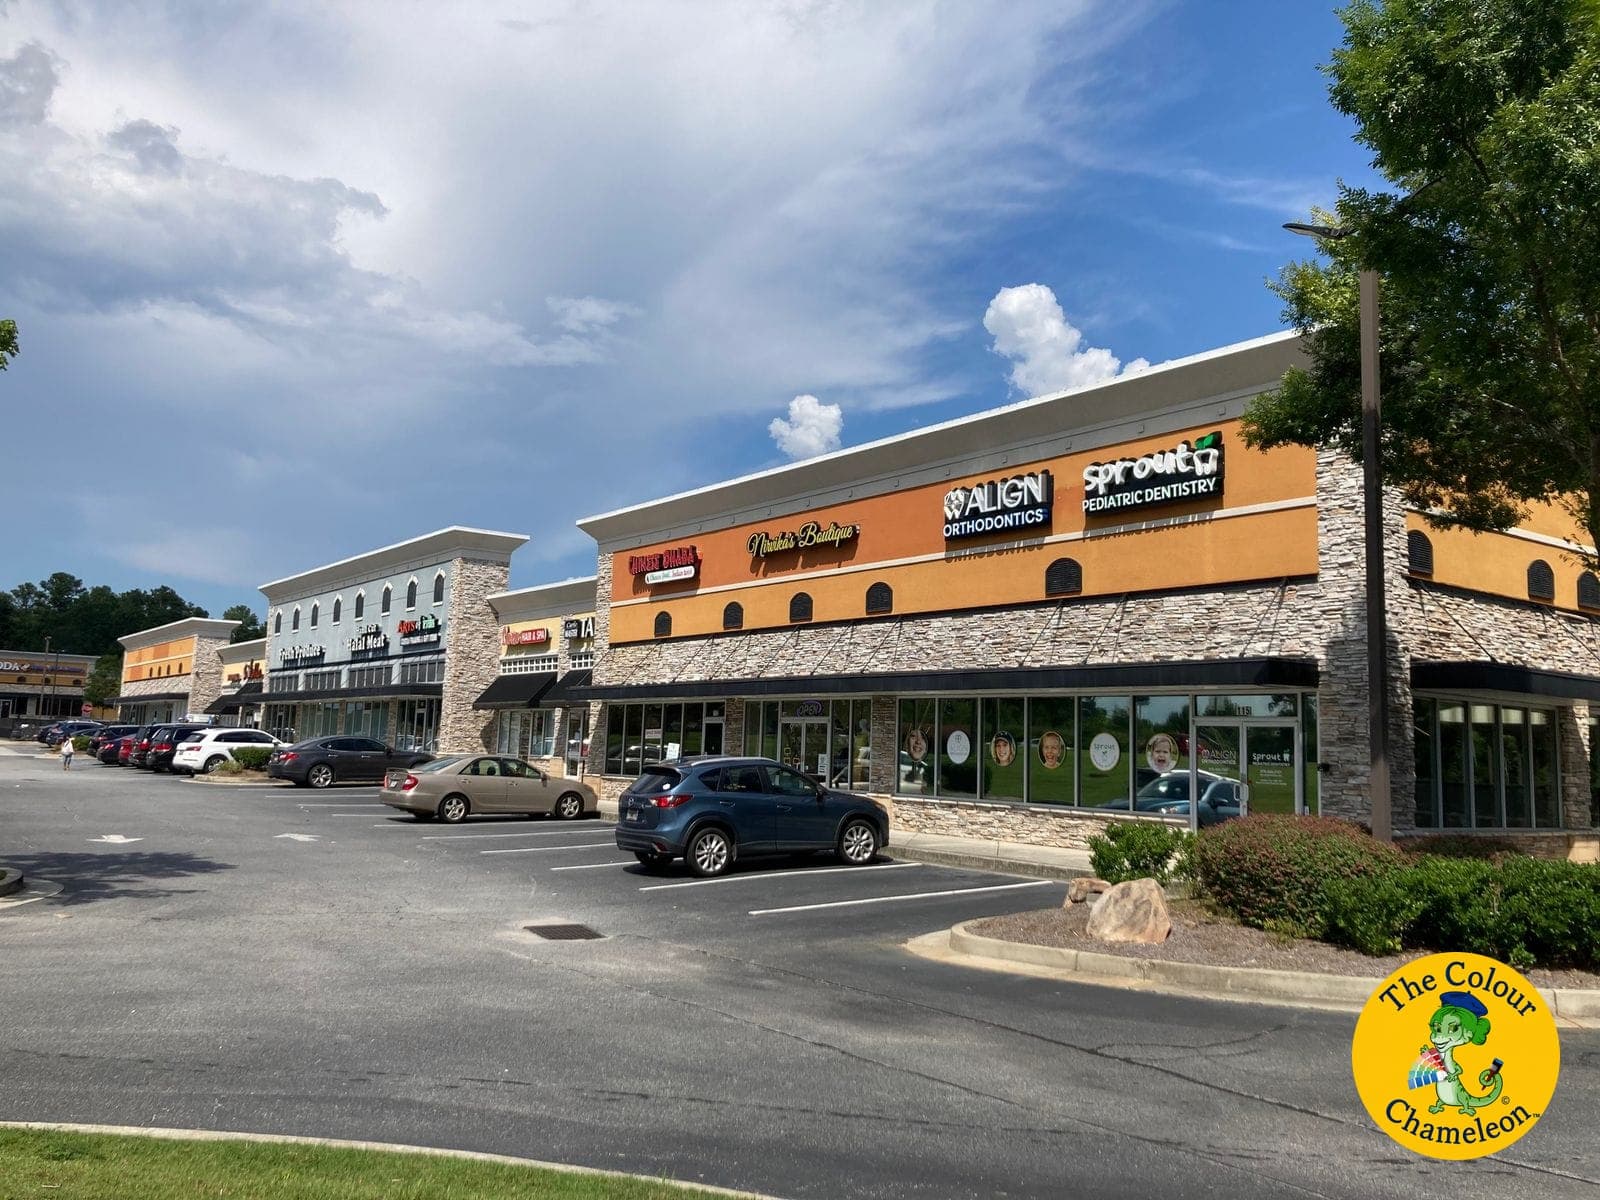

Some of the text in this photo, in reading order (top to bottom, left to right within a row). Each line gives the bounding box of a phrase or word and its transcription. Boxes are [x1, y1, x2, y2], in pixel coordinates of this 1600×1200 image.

[1083, 443, 1195, 495] sprout
[965, 473, 1044, 516] ALIGN
[1082, 477, 1216, 512] PEDIATRIC DENTISTRY
[943, 508, 1044, 537] ORTHODONTICS
[747, 522, 854, 557] Nirvika's Boutique
[279, 643, 321, 662] Fresh Produce
[366, 633, 386, 650] Meat
[0, 661, 20, 671] DA
[800, 703, 818, 716] OPEN
[1252, 752, 1281, 762] sprout
